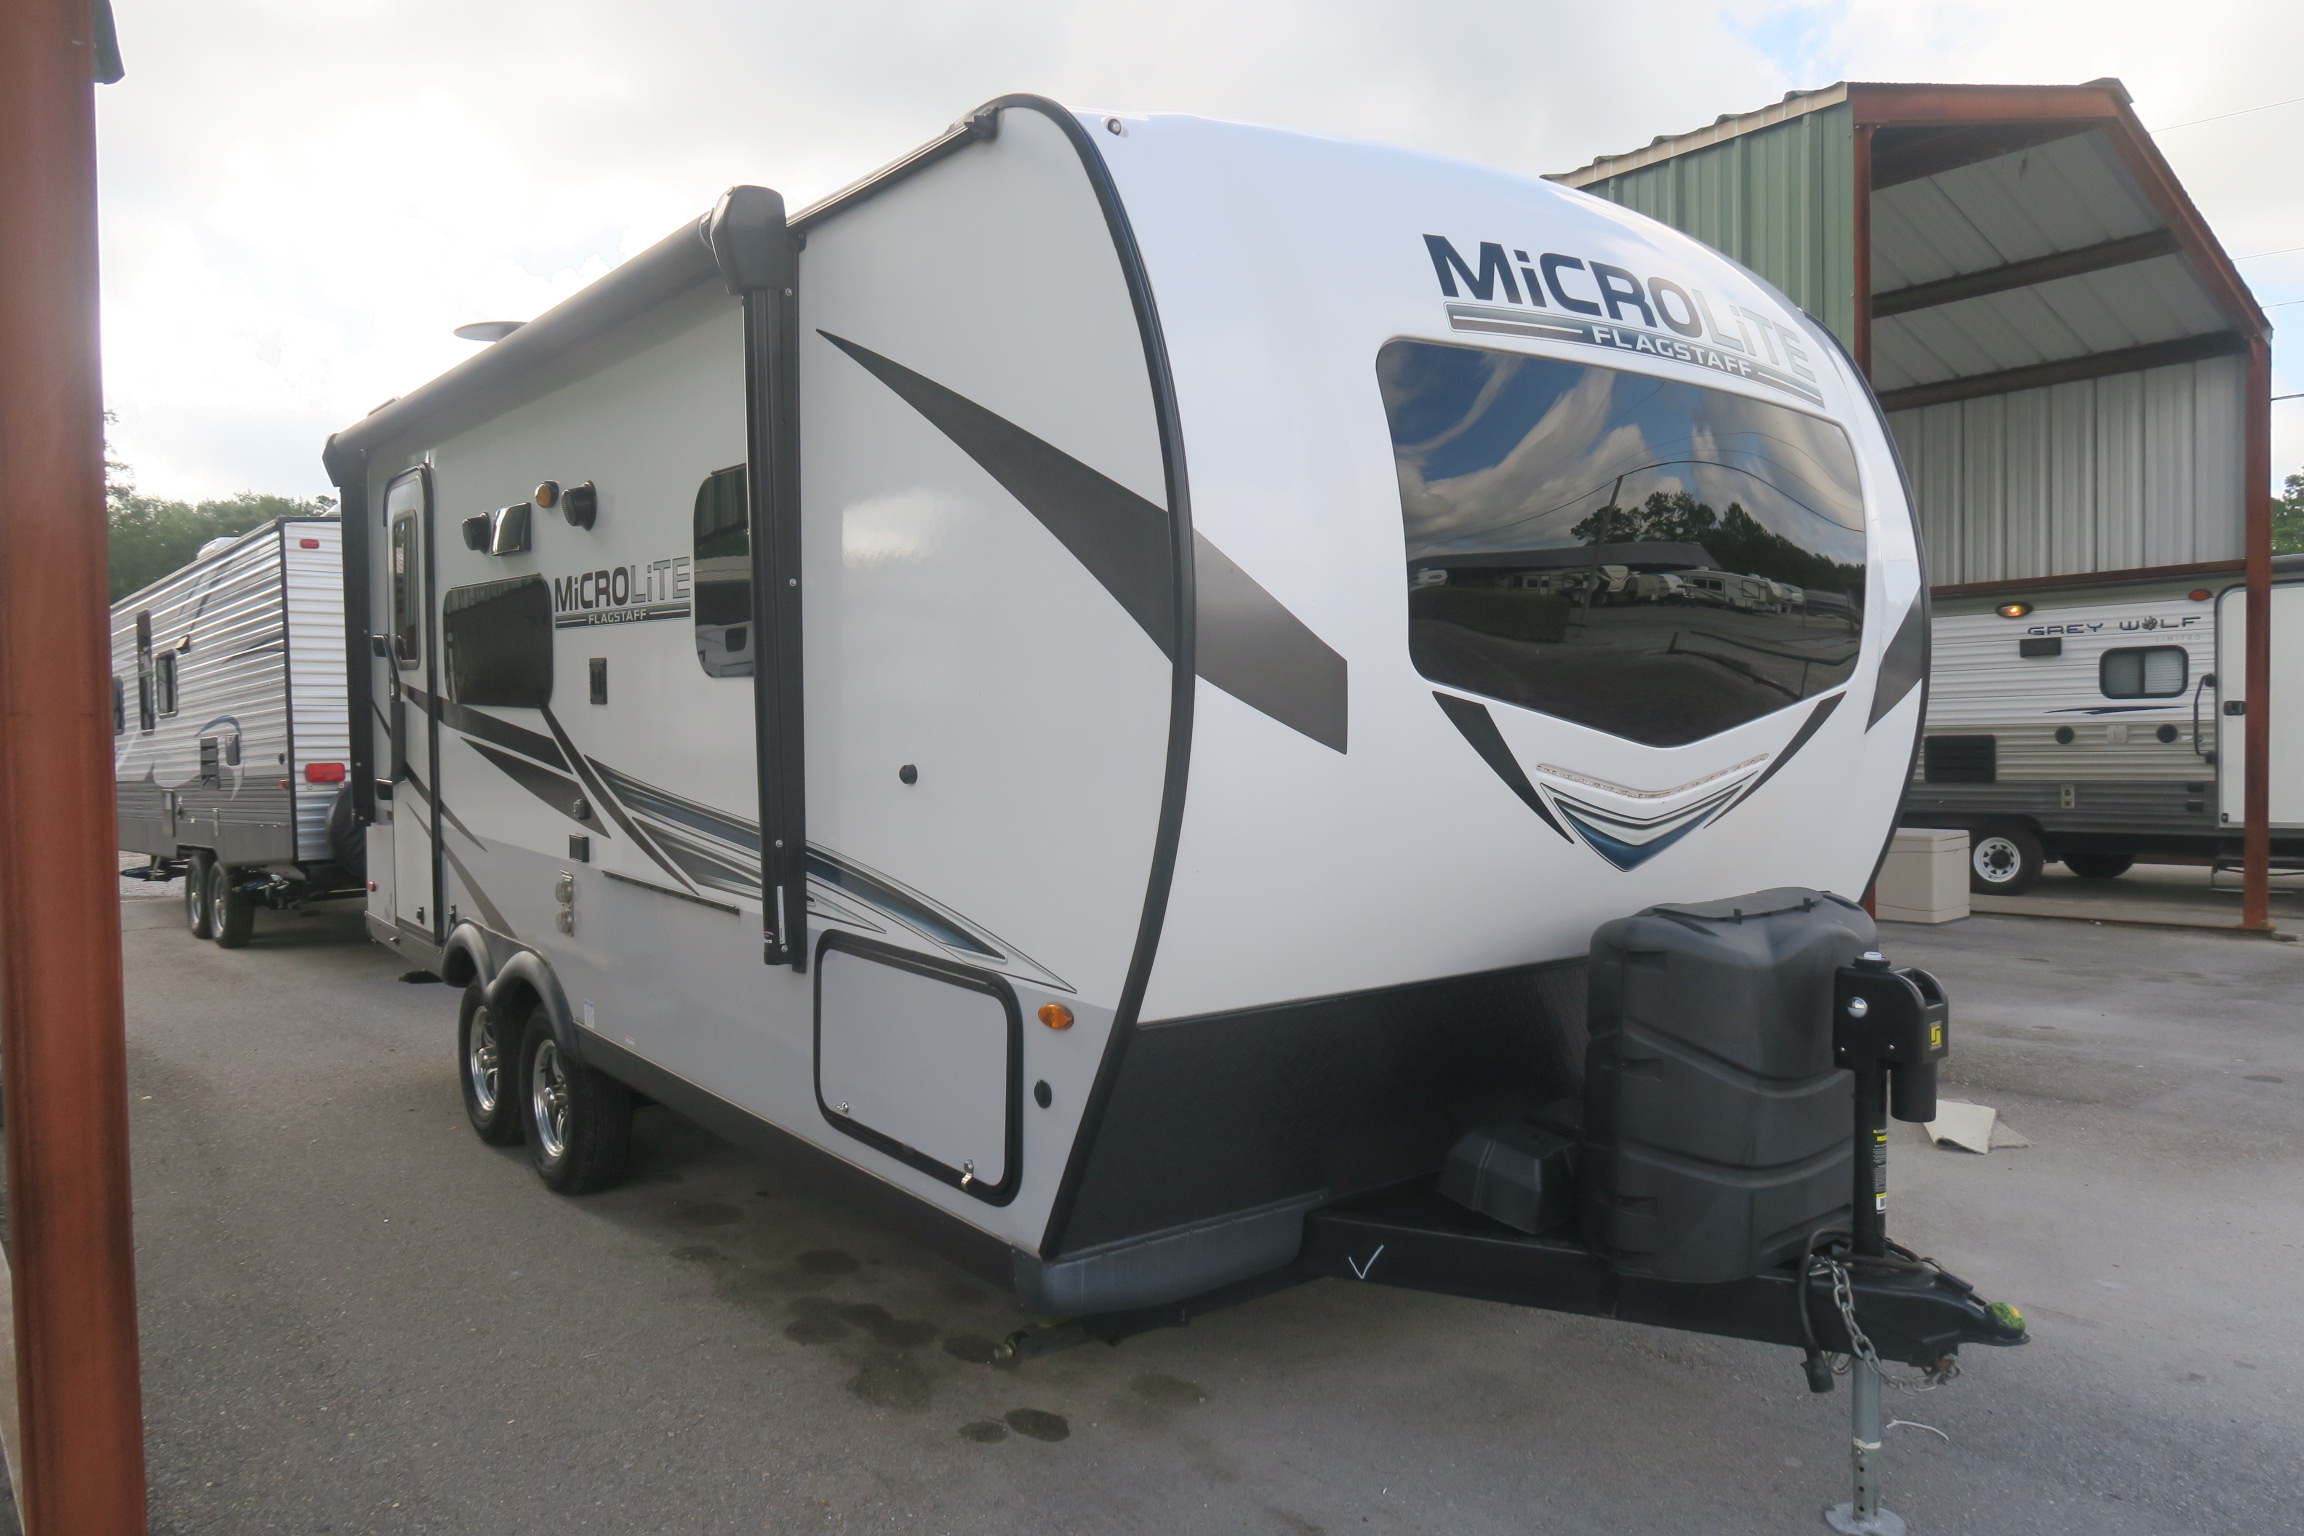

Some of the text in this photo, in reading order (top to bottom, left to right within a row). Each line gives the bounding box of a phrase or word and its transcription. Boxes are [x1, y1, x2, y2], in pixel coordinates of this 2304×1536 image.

[1591, 325, 1753, 376] FLAGSTAFF
[588, 608, 647, 625] FLAGSTAFF
[2027, 615, 2202, 636] GREY WOLF
